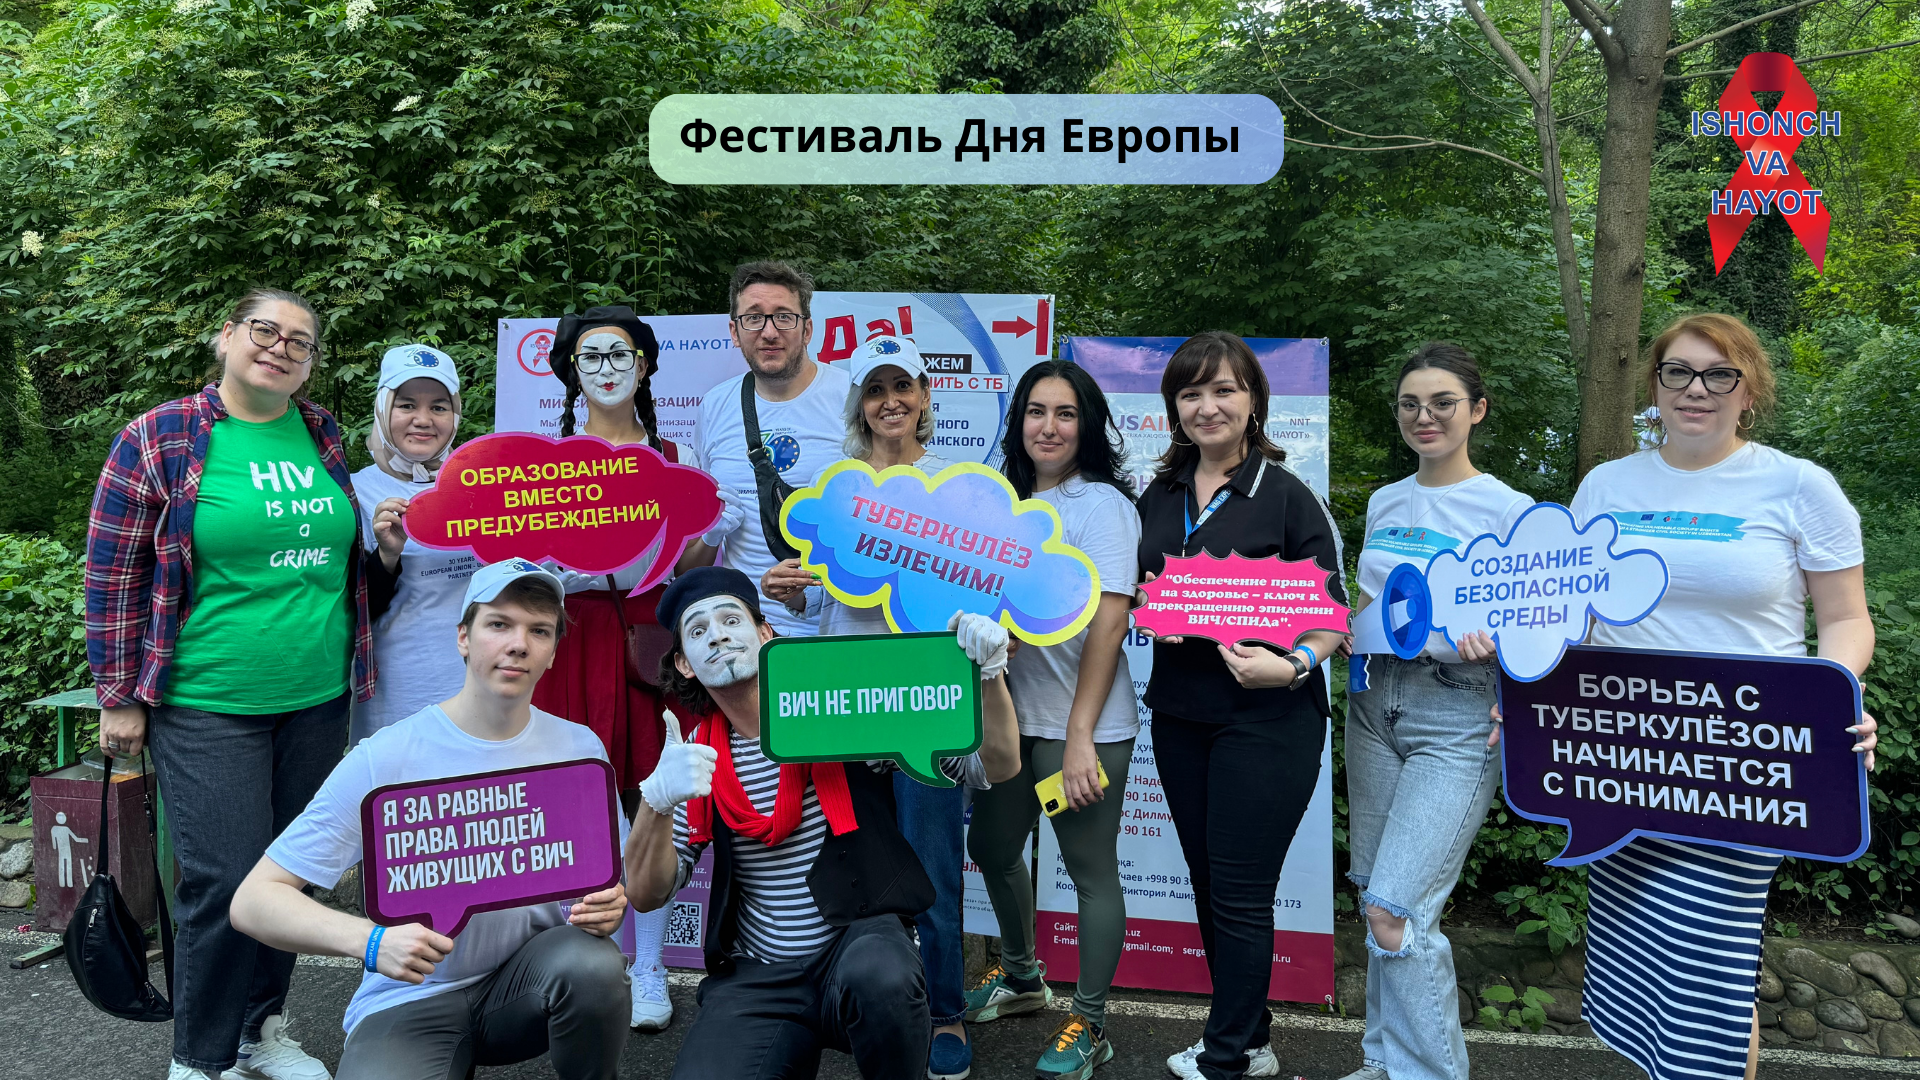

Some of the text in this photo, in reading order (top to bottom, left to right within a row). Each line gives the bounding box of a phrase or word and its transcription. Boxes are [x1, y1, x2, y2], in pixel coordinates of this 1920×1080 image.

[926, 357, 964, 369] ЖЕМ
[930, 377, 1003, 389] ИТЬ С ТБ
[937, 419, 969, 429] НОГО
[925, 436, 985, 447] АНСКОГО
[249, 461, 315, 492] HIV
[460, 456, 639, 486] ОБРАЗОВАНИЕ
[266, 497, 334, 518] IS NOT
[504, 484, 603, 508] ВМЕСТО
[300, 524, 310, 537] a
[446, 500, 660, 538] ПРЕДУБЕЖДЕНИЙ
[851, 496, 1034, 569] ТУБЕРКУЛЁЗ
[270, 548, 331, 569] CRIME
[853, 532, 1005, 597] ИЗЛЕЧИМ!
[1471, 546, 1593, 577] СОЗДАНИЕ
[421, 567, 452, 576] EUROPEAN
[1165, 574, 1315, 589] "Обеспечение права
[1160, 589, 1177, 597] на
[1182, 590, 1249, 601] здоровье
[1264, 592, 1305, 601] ключ
[1309, 592, 1320, 601] к
[1455, 568, 1610, 605] БЕЗОПАСНОЙ
[1148, 602, 1334, 615] прекращению эпидемии
[1487, 604, 1568, 629] СРЕДЫ
[1188, 615, 1291, 628] ВИЧ/СПИДа".
[778, 684, 963, 717] ВИЧ НЕ ПРИГОВОР
[1578, 673, 1760, 711] БОРЬБА С
[1531, 702, 1812, 754] ТУБЕРКУЛЁЗОМ
[1552, 739, 1792, 789] НАЧИНАЕТСЯ
[383, 781, 528, 827] Я ЗА РАВНЫЕ
[1143, 793, 1162, 803] 160
[1542, 771, 1808, 828] С ПОНИМАНИЯ
[385, 806, 546, 860] ПРАВА ЛЮДЕЙ
[1125, 825, 1161, 837] 90 161
[387, 840, 574, 893] ЖИВУЩИХ С ВИЧ
[1144, 874, 1167, 883] +998
[1170, 876, 1181, 885] 90
[1122, 886, 1166, 898] Виктория
[1284, 899, 1302, 908] 173
[1054, 922, 1077, 932] Сайт:
